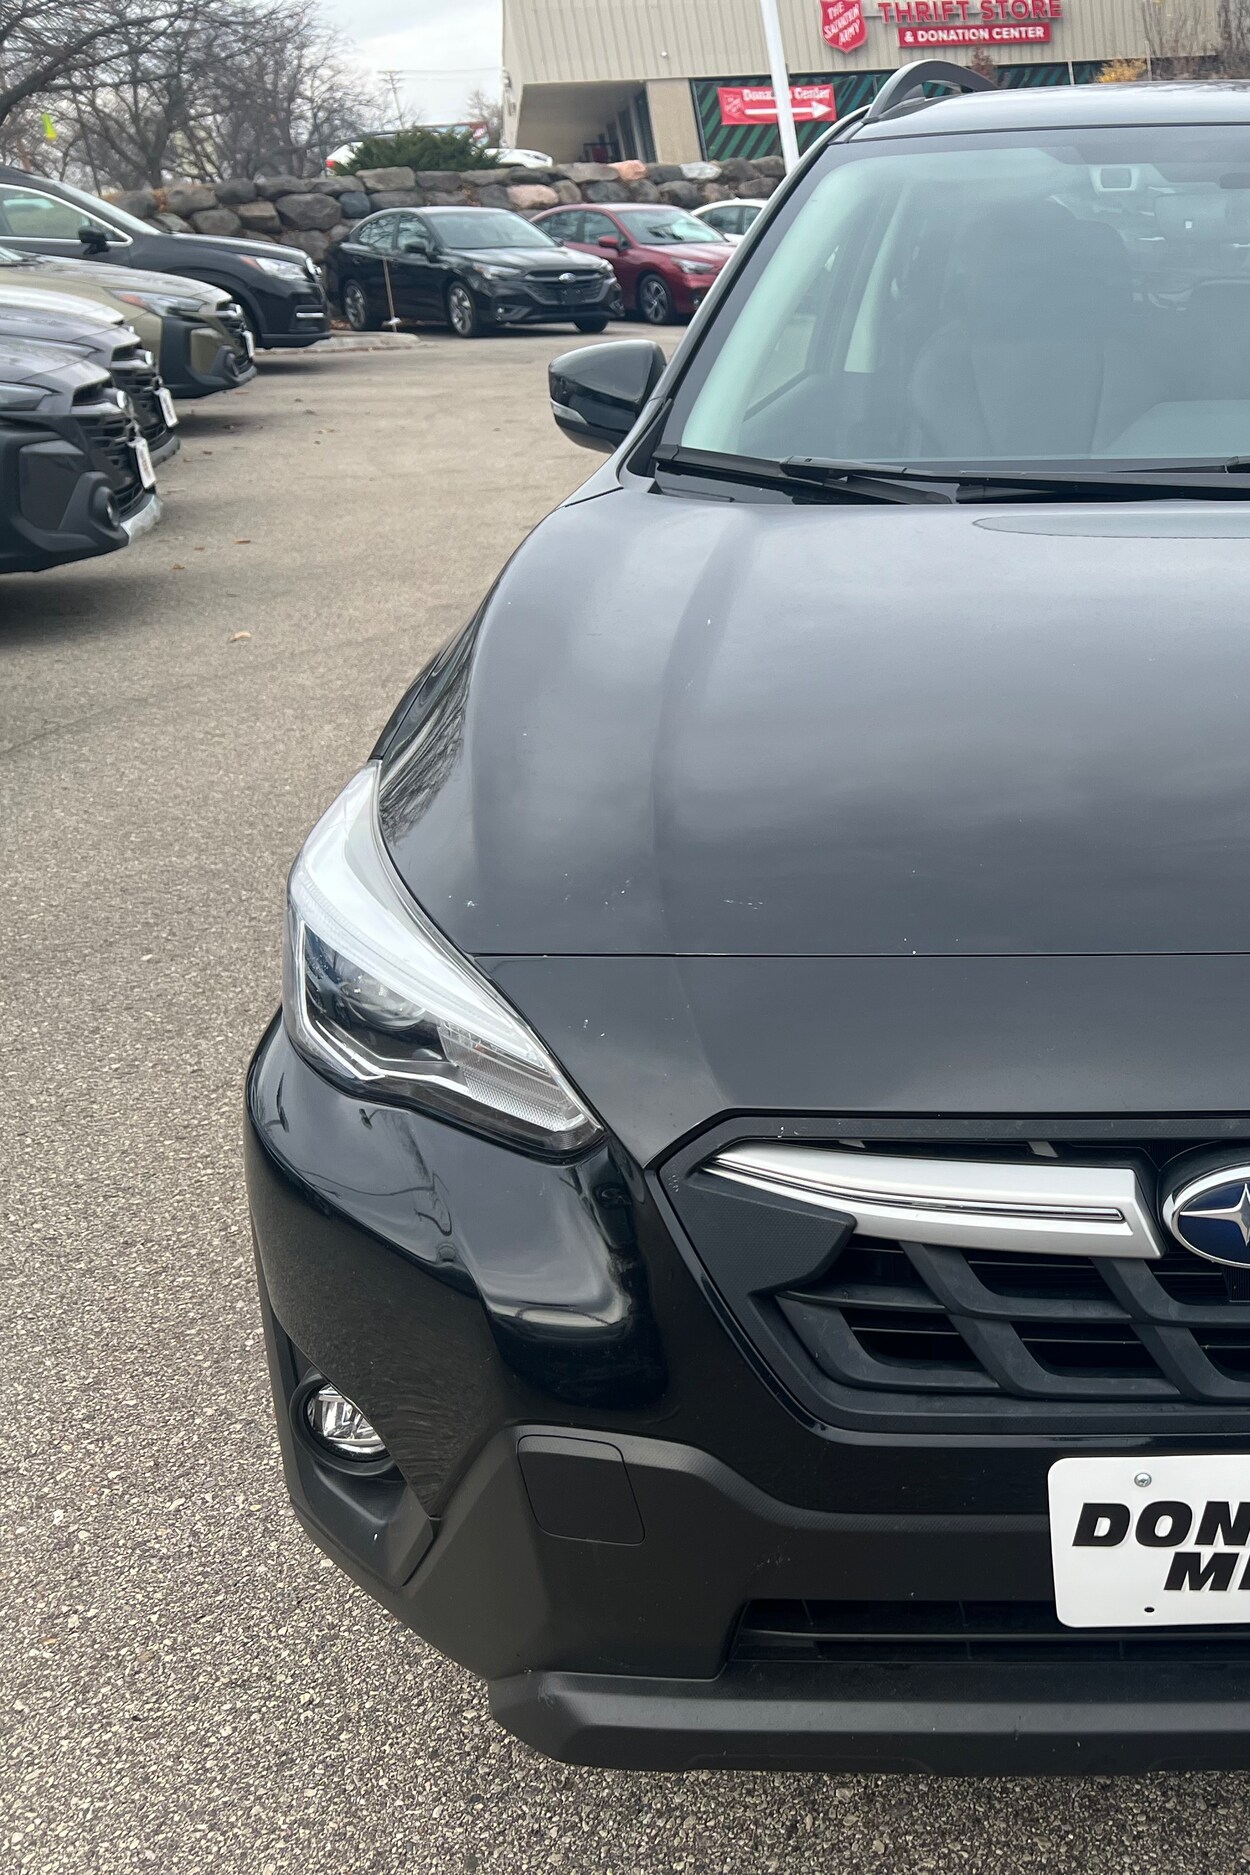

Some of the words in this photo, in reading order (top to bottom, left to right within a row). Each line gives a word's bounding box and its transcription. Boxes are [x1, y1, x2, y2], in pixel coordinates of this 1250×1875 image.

[827, 1, 845, 20] THE
[878, 0, 969, 24] THRIFT
[980, 0, 1063, 21] STORE
[838, 19, 860, 46] ARMY
[904, 31, 914, 43] &
[917, 28, 989, 43] DONATION
[992, 26, 1045, 39] CENTER
[794, 87, 831, 100] Center
